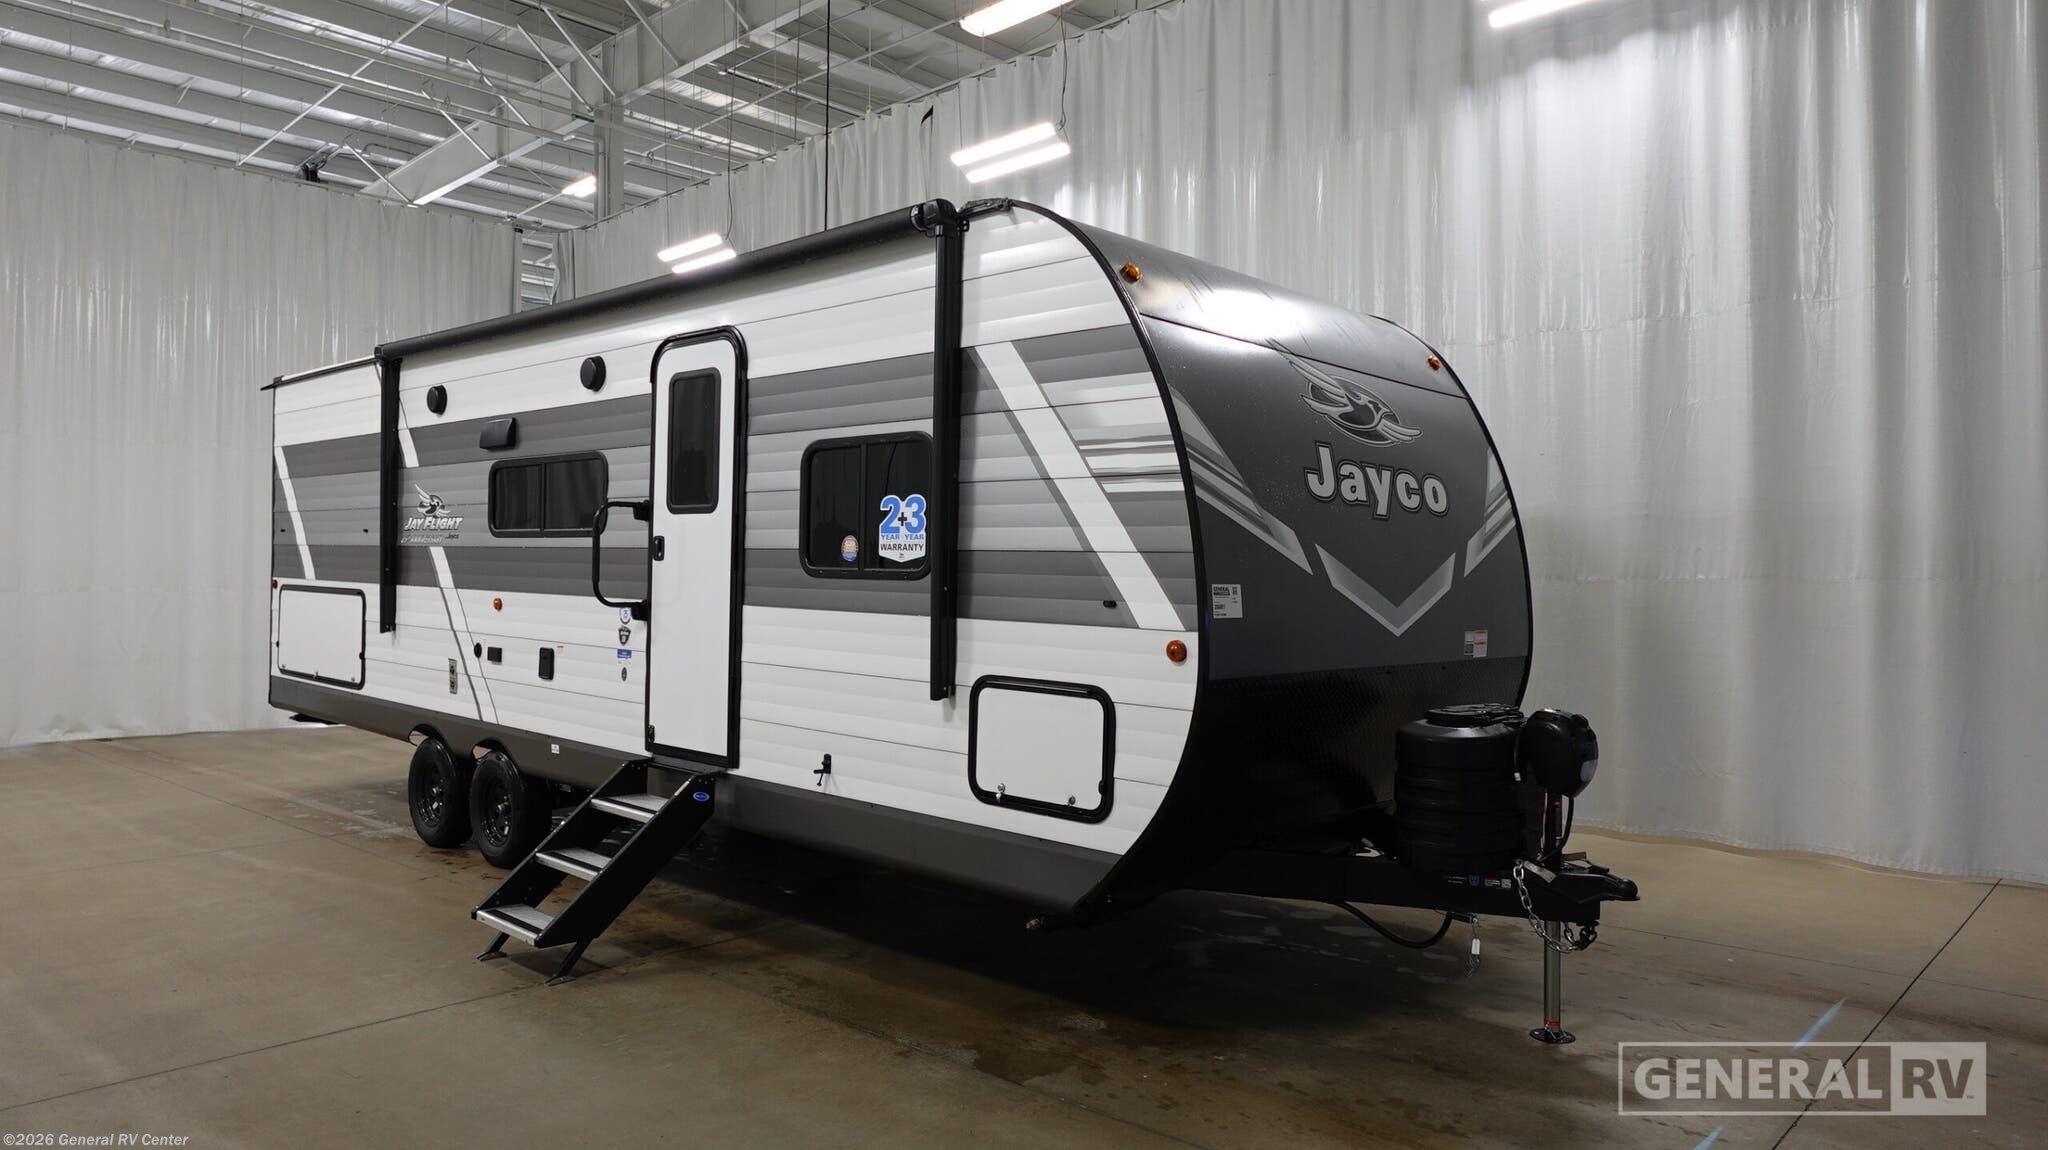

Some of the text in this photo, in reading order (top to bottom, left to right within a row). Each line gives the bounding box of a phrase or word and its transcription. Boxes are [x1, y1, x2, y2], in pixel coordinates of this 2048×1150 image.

[1304, 441, 1449, 519] Jayco
[404, 516, 463, 530] JAY FLIGHT
[880, 543, 924, 552] WARRANTY
